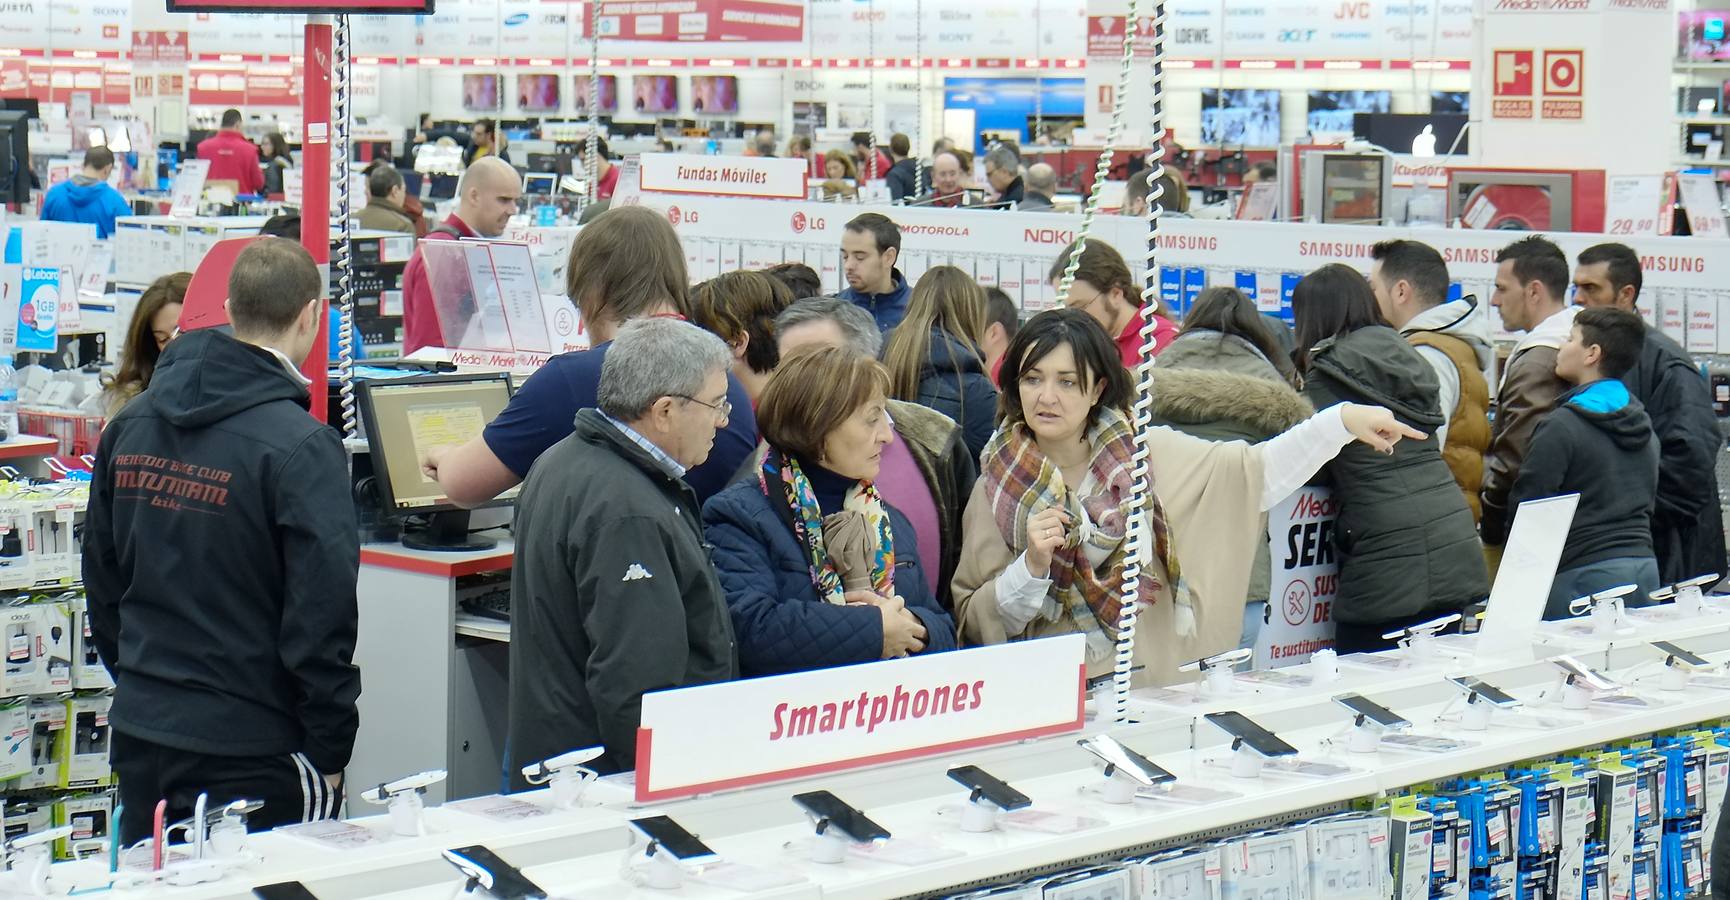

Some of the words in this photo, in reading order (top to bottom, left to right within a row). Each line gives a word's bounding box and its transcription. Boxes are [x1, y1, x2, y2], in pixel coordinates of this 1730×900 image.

[1334, 2, 1370, 19] JVC
[678, 165, 717, 182] Fundas
[721, 167, 767, 185] Móviles
[684, 211, 698, 223] LG
[810, 217, 825, 230] LG
[901, 224, 969, 237] MOTOROLA
[1024, 228, 1073, 245] NOKI
[1150, 234, 1217, 251] AMSUNG
[1270, 643, 1280, 660] Te
[769, 680, 985, 741] Smartphones
